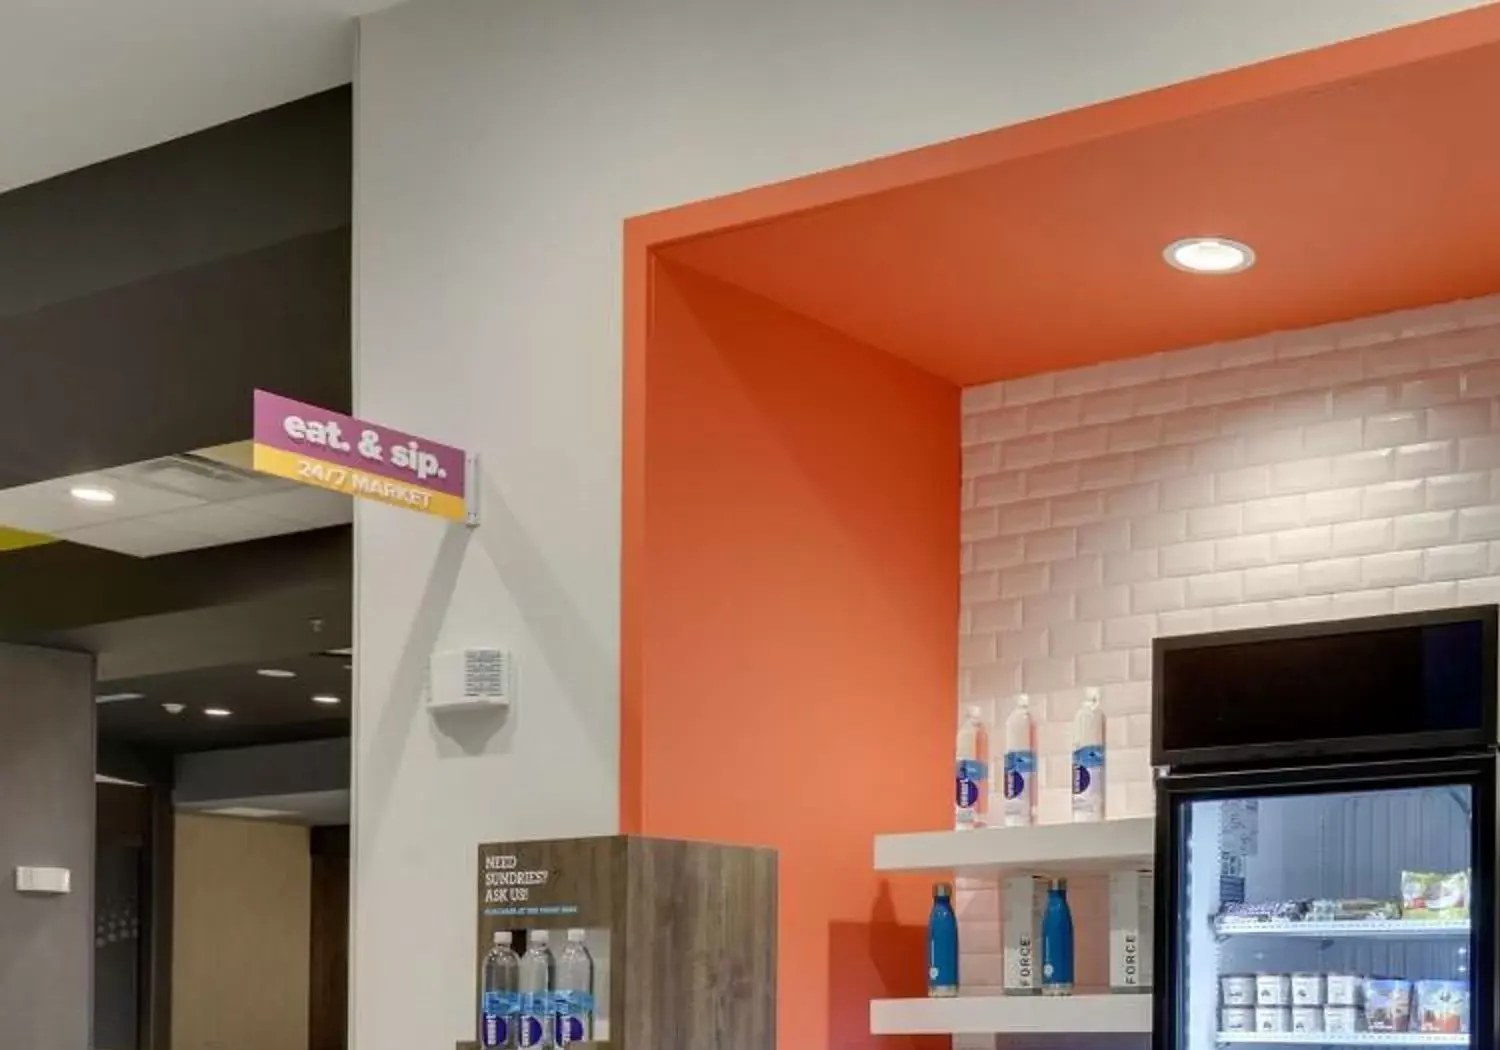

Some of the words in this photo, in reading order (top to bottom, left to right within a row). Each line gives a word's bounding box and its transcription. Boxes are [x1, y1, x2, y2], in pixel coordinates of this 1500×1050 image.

[284, 415, 350, 451] eat.
[358, 429, 383, 461] &
[391, 441, 447, 479] sip.
[297, 460, 346, 487] 24/7
[352, 473, 432, 509] MARKET
[485, 855, 517, 869] NEED
[485, 888, 508, 902] ASK
[1020, 938, 1031, 987] FORCE
[1126, 934, 1137, 984] FORCE
